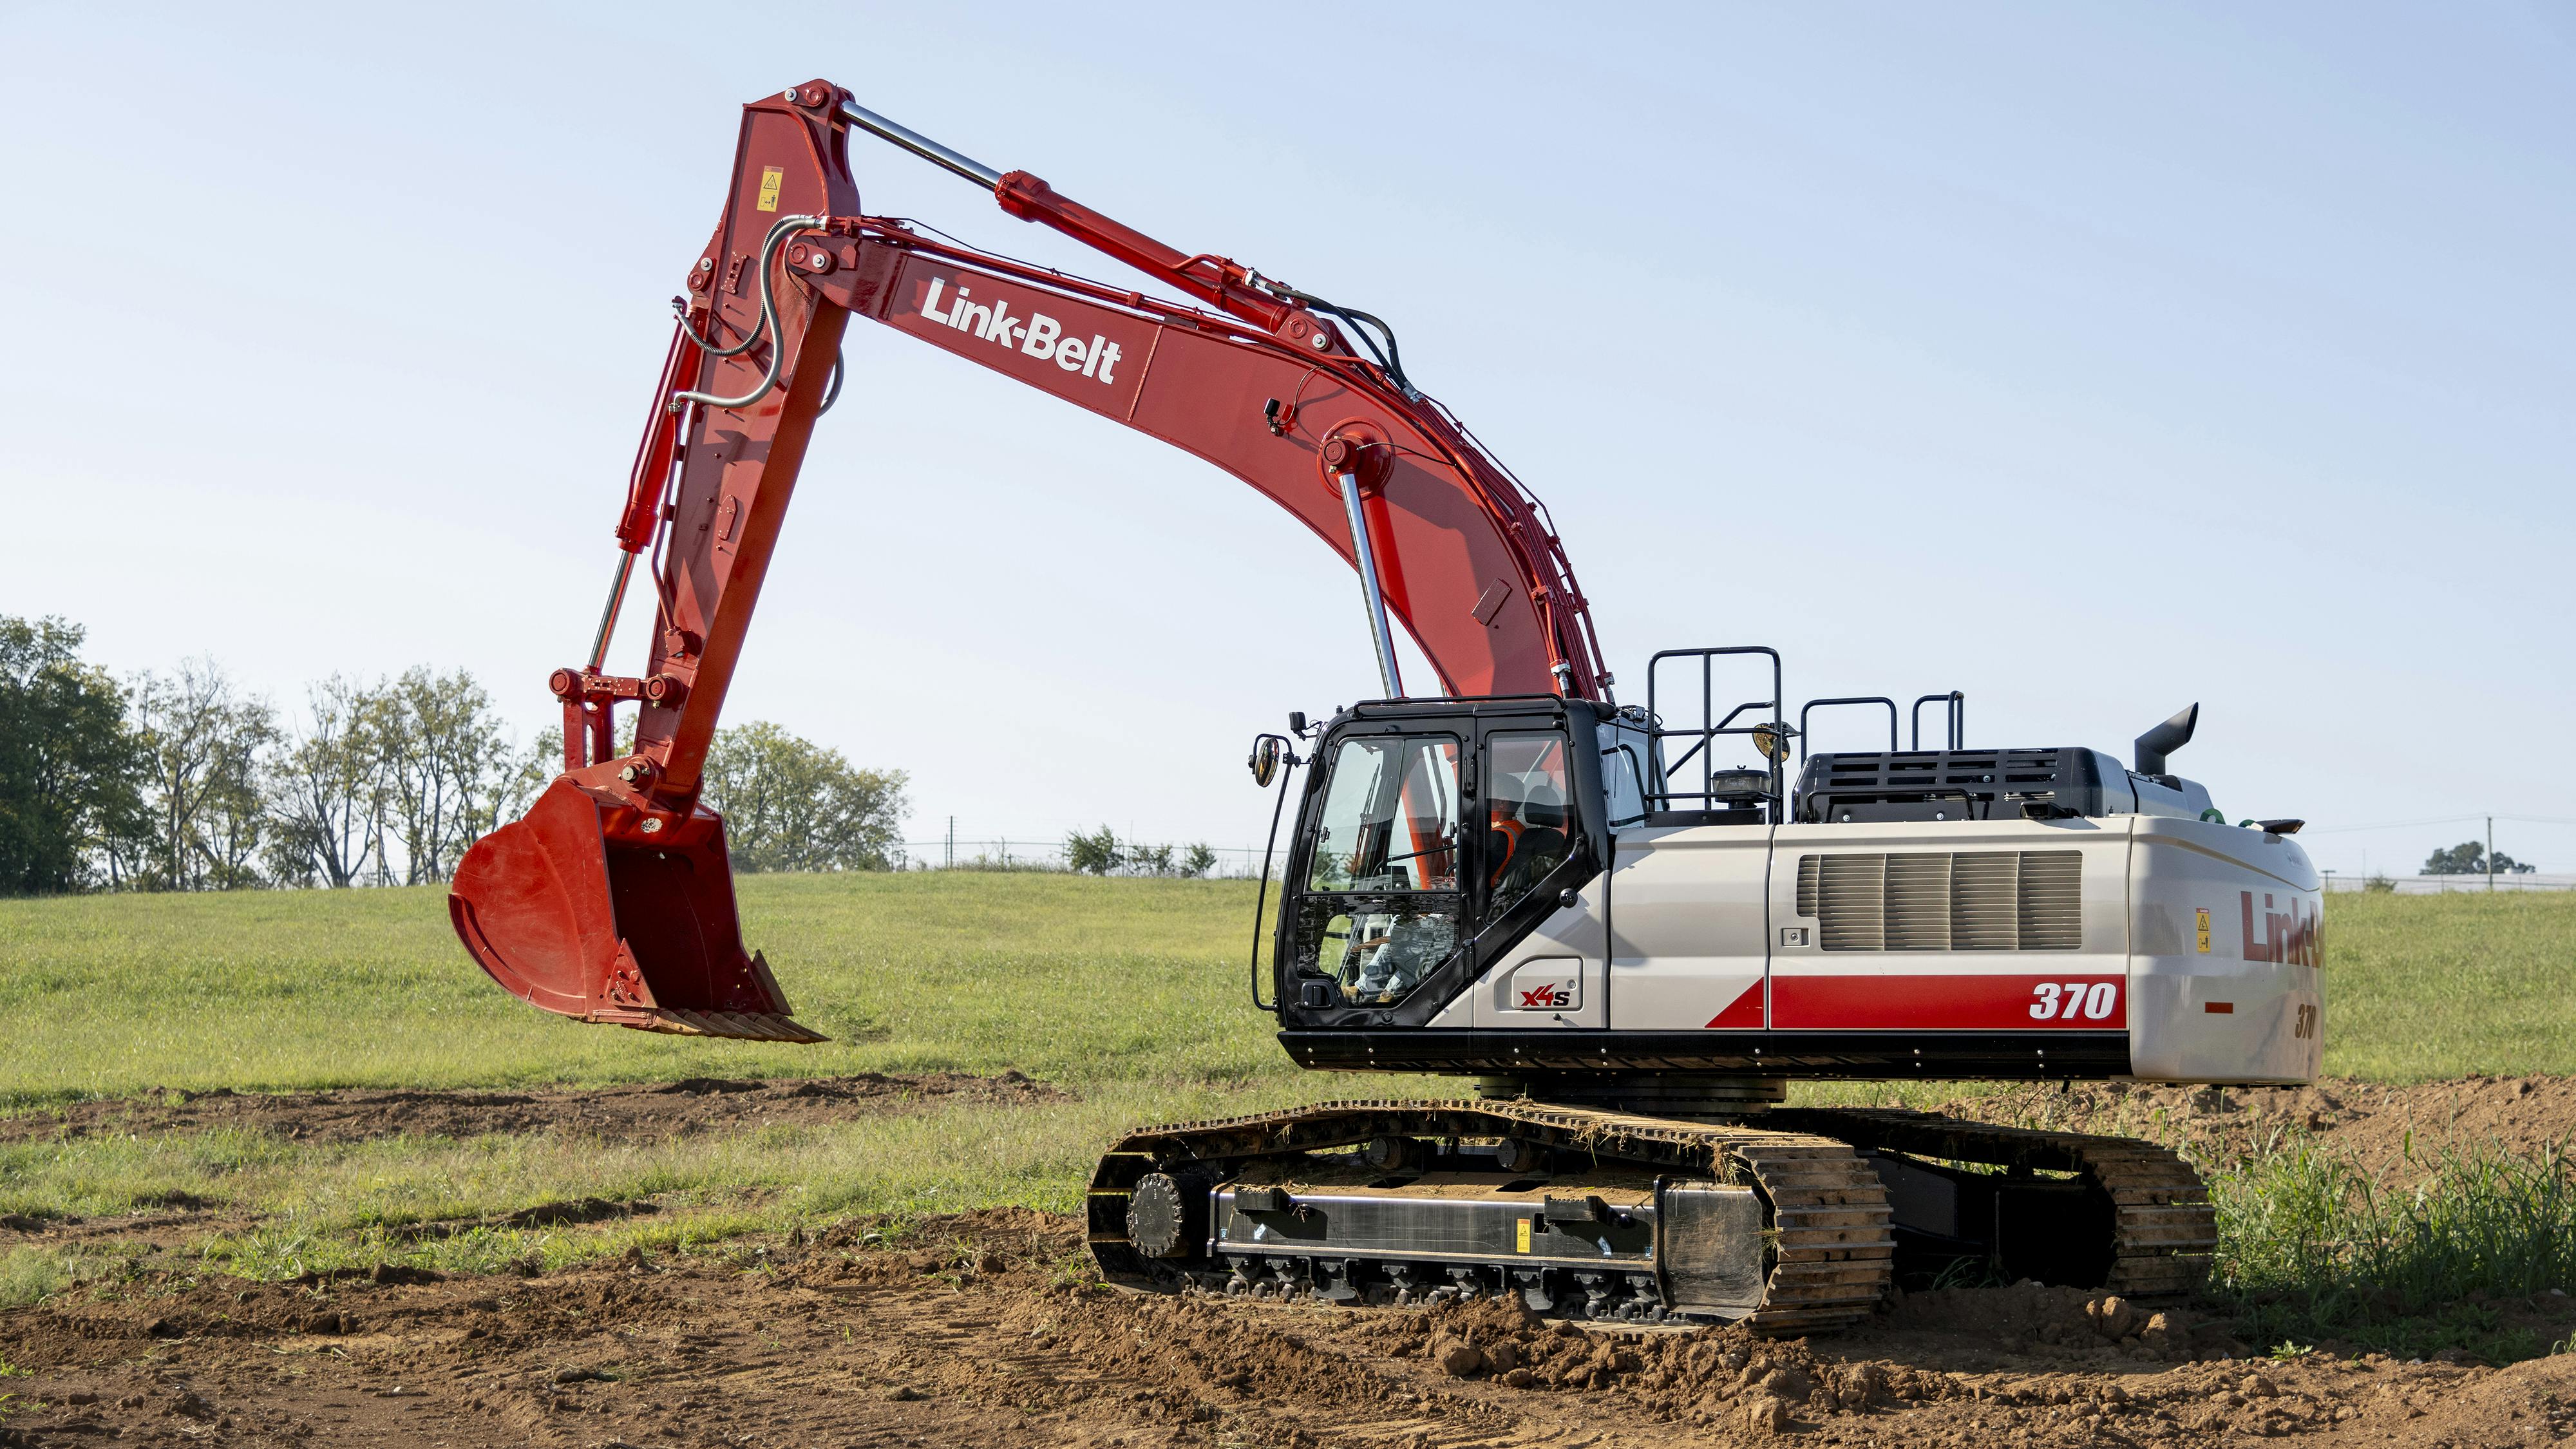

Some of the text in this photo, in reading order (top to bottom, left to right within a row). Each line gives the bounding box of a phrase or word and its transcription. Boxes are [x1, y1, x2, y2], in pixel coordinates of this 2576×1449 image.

[921, 277, 1121, 384] Link-Belt
[2029, 983, 2116, 1019] 370
[2295, 1003, 2316, 1039] 370
